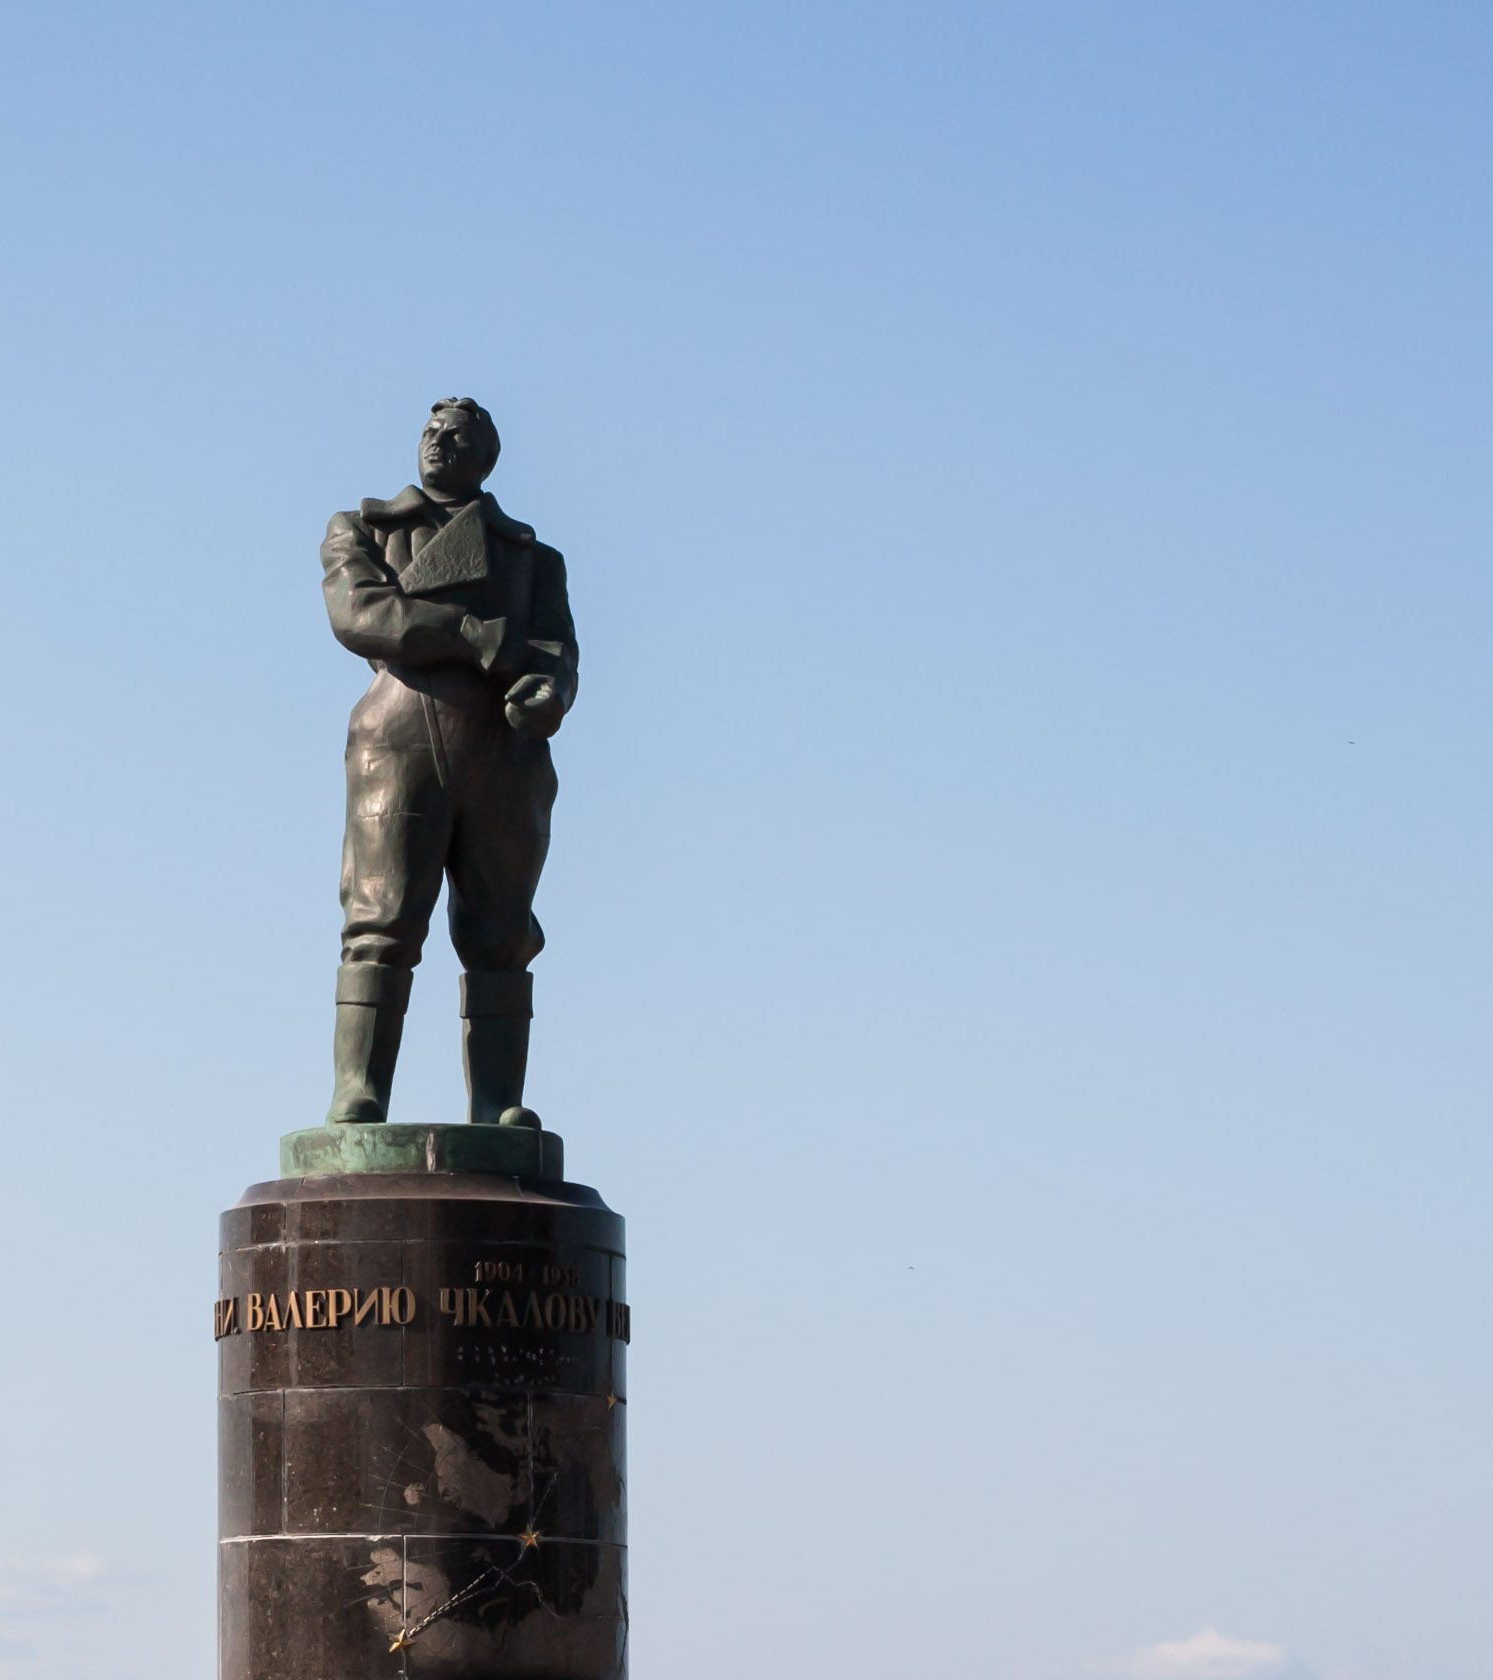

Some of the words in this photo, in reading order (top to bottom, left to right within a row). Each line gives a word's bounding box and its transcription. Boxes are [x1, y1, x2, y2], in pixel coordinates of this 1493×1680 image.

[473, 1260, 523, 1284] 1904
[246, 1286, 417, 1332] ВАЛЕРИЮ
[438, 1287, 601, 1333] ЧКАЛОВУ
